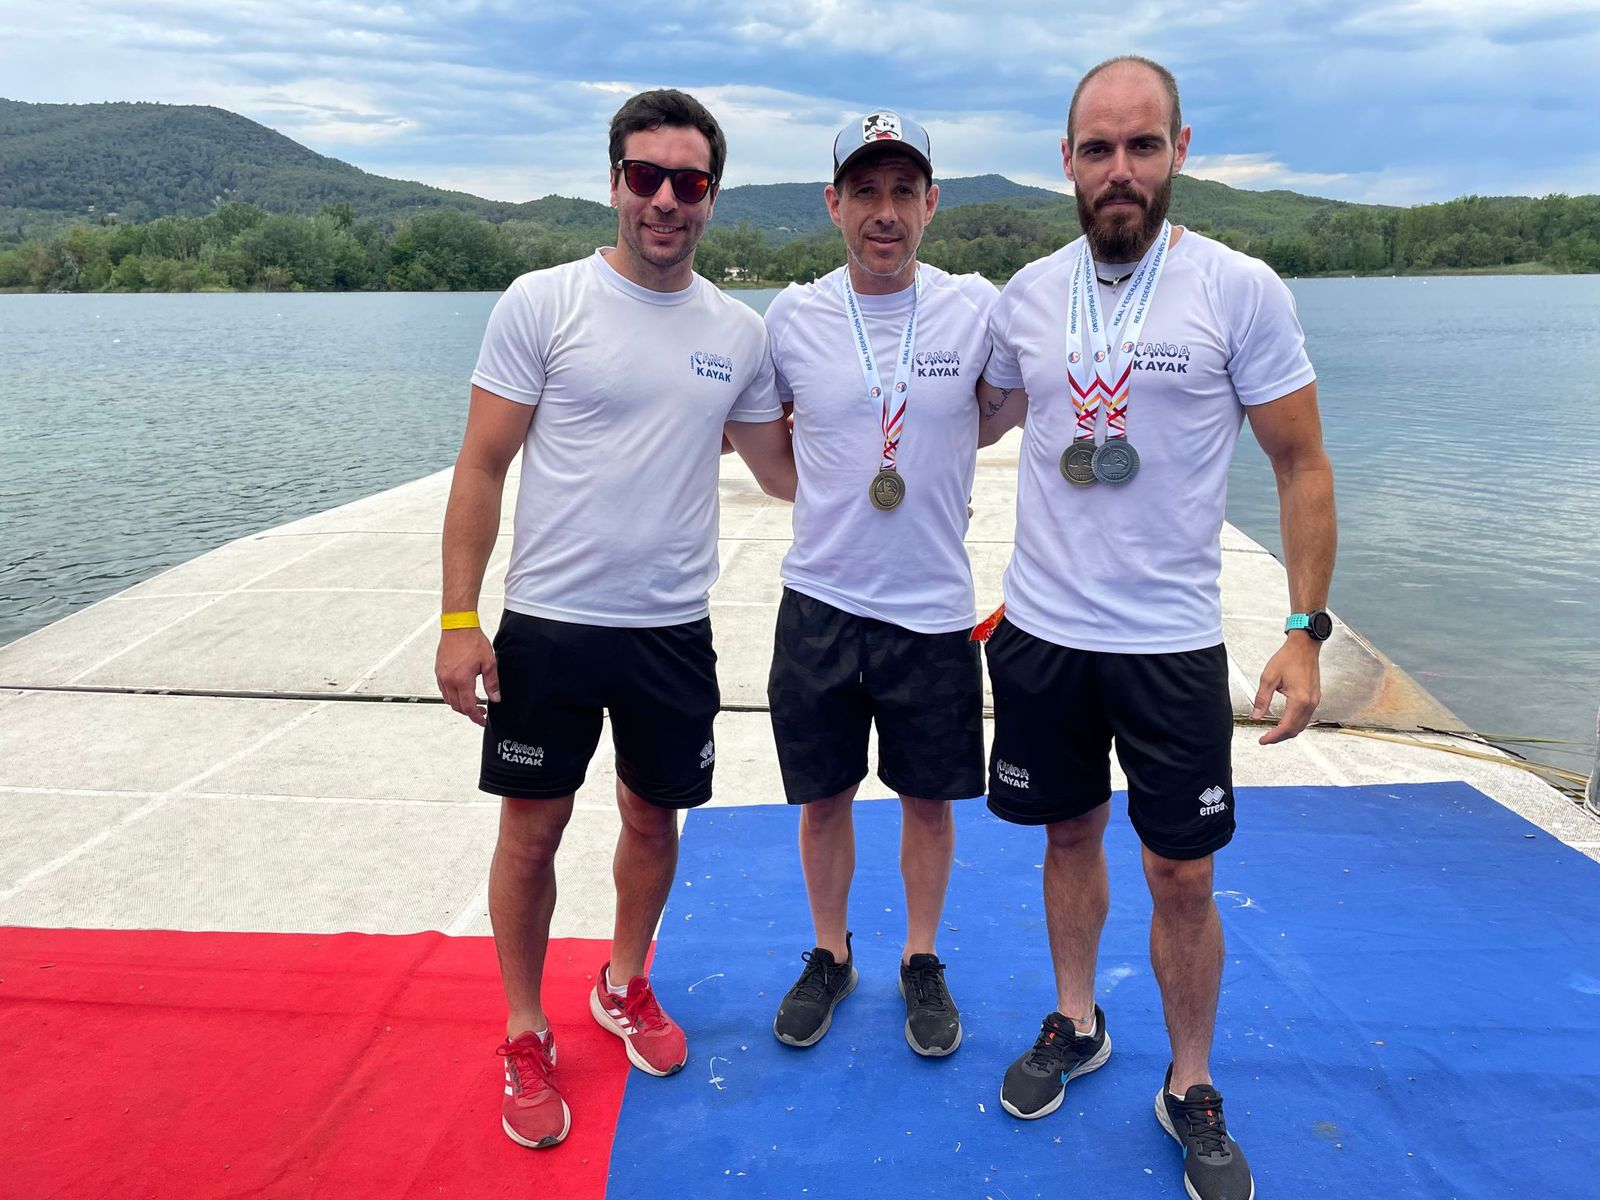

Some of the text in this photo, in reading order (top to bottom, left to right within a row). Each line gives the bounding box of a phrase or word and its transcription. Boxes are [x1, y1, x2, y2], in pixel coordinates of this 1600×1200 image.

[1113, 309, 1126, 326] REAL
[1133, 307, 1145, 324] REAL
[902, 349, 910, 365] REAL
[915, 350, 960, 366] CANOA
[1134, 342, 1190, 361] CANOA
[694, 351, 732, 372] CANOA
[865, 355, 873, 371] REAL
[1133, 360, 1188, 374] KAYAK
[697, 367, 731, 383] KAYAK
[918, 368, 960, 377] KAYAK
[502, 739, 544, 759] CANOA
[502, 752, 543, 767] KAYAK
[999, 771, 1030, 789] KAYAK
